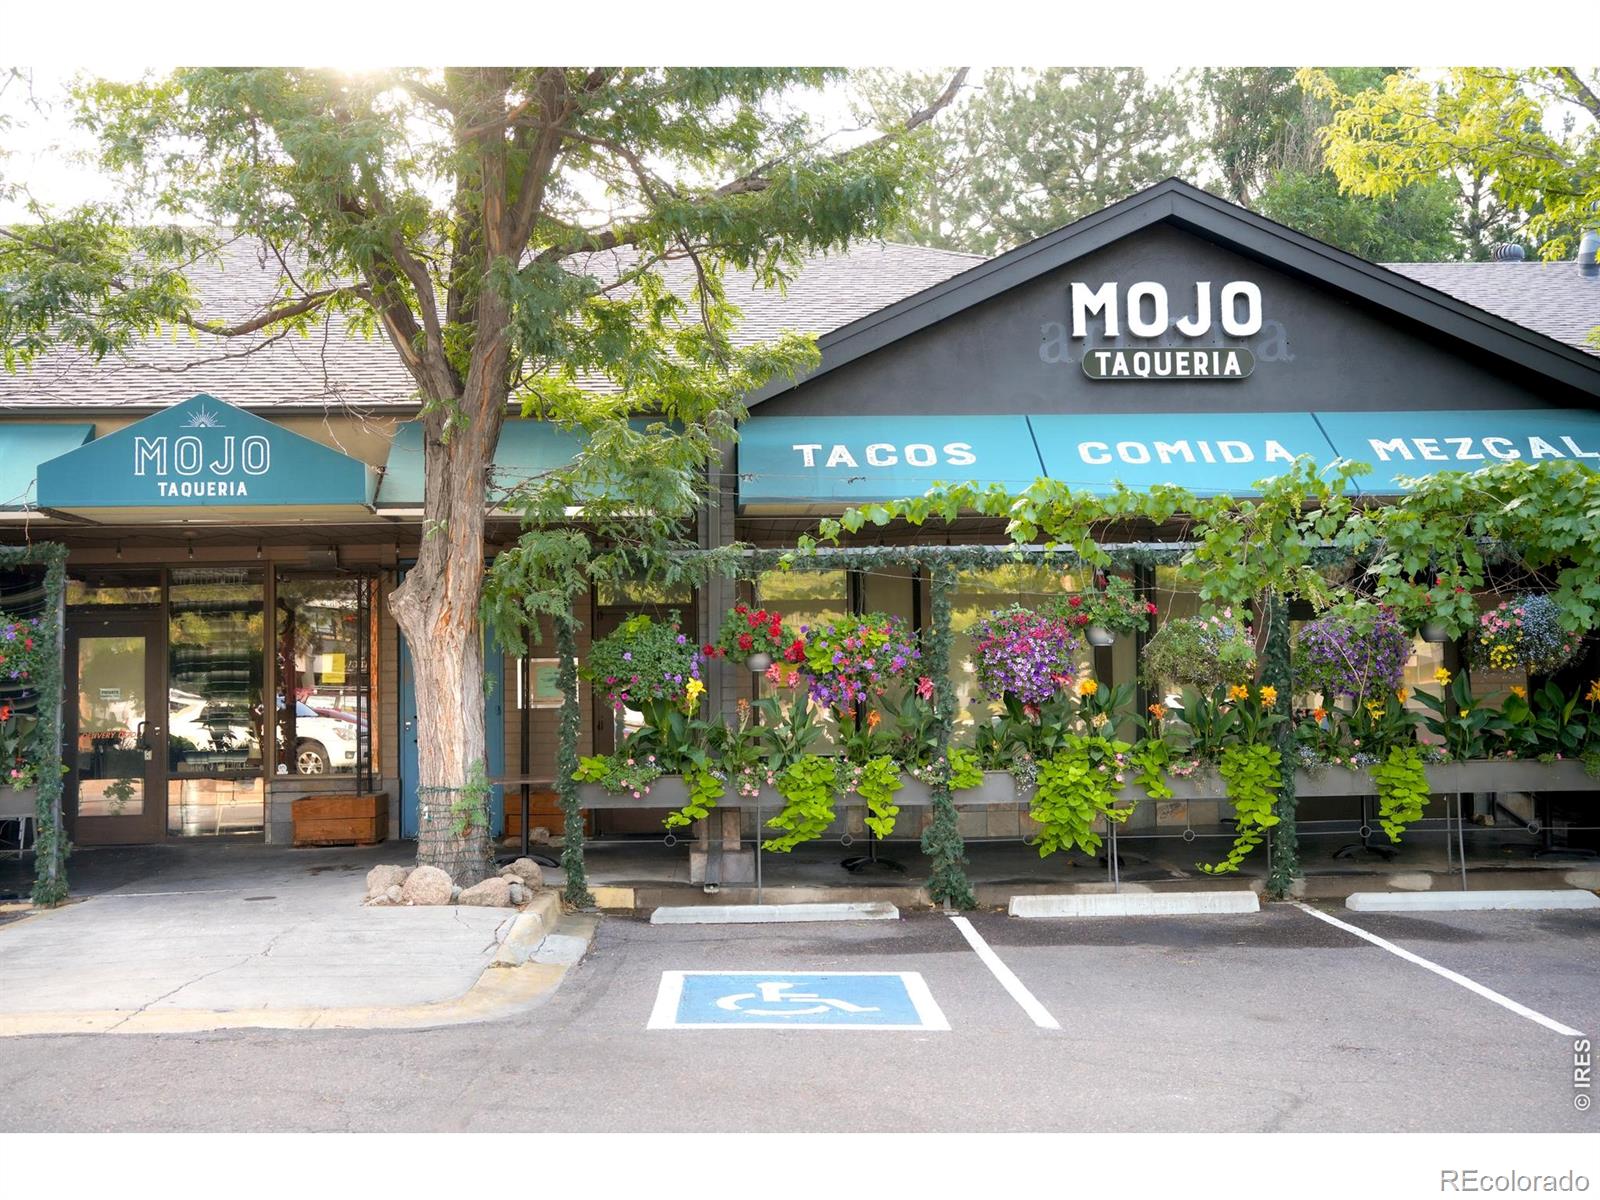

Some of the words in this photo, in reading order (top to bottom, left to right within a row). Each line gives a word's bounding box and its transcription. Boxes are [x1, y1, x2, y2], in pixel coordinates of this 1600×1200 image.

[1070, 280, 1263, 338] MOJO
[1095, 351, 1242, 378] TAQUERIA
[134, 435, 271, 476] MOJO
[792, 442, 977, 467] TACOS
[1077, 440, 1295, 465] COMIDA
[1367, 435, 1600, 461] MEZCAL
[158, 481, 248, 497] TAQUERIA
